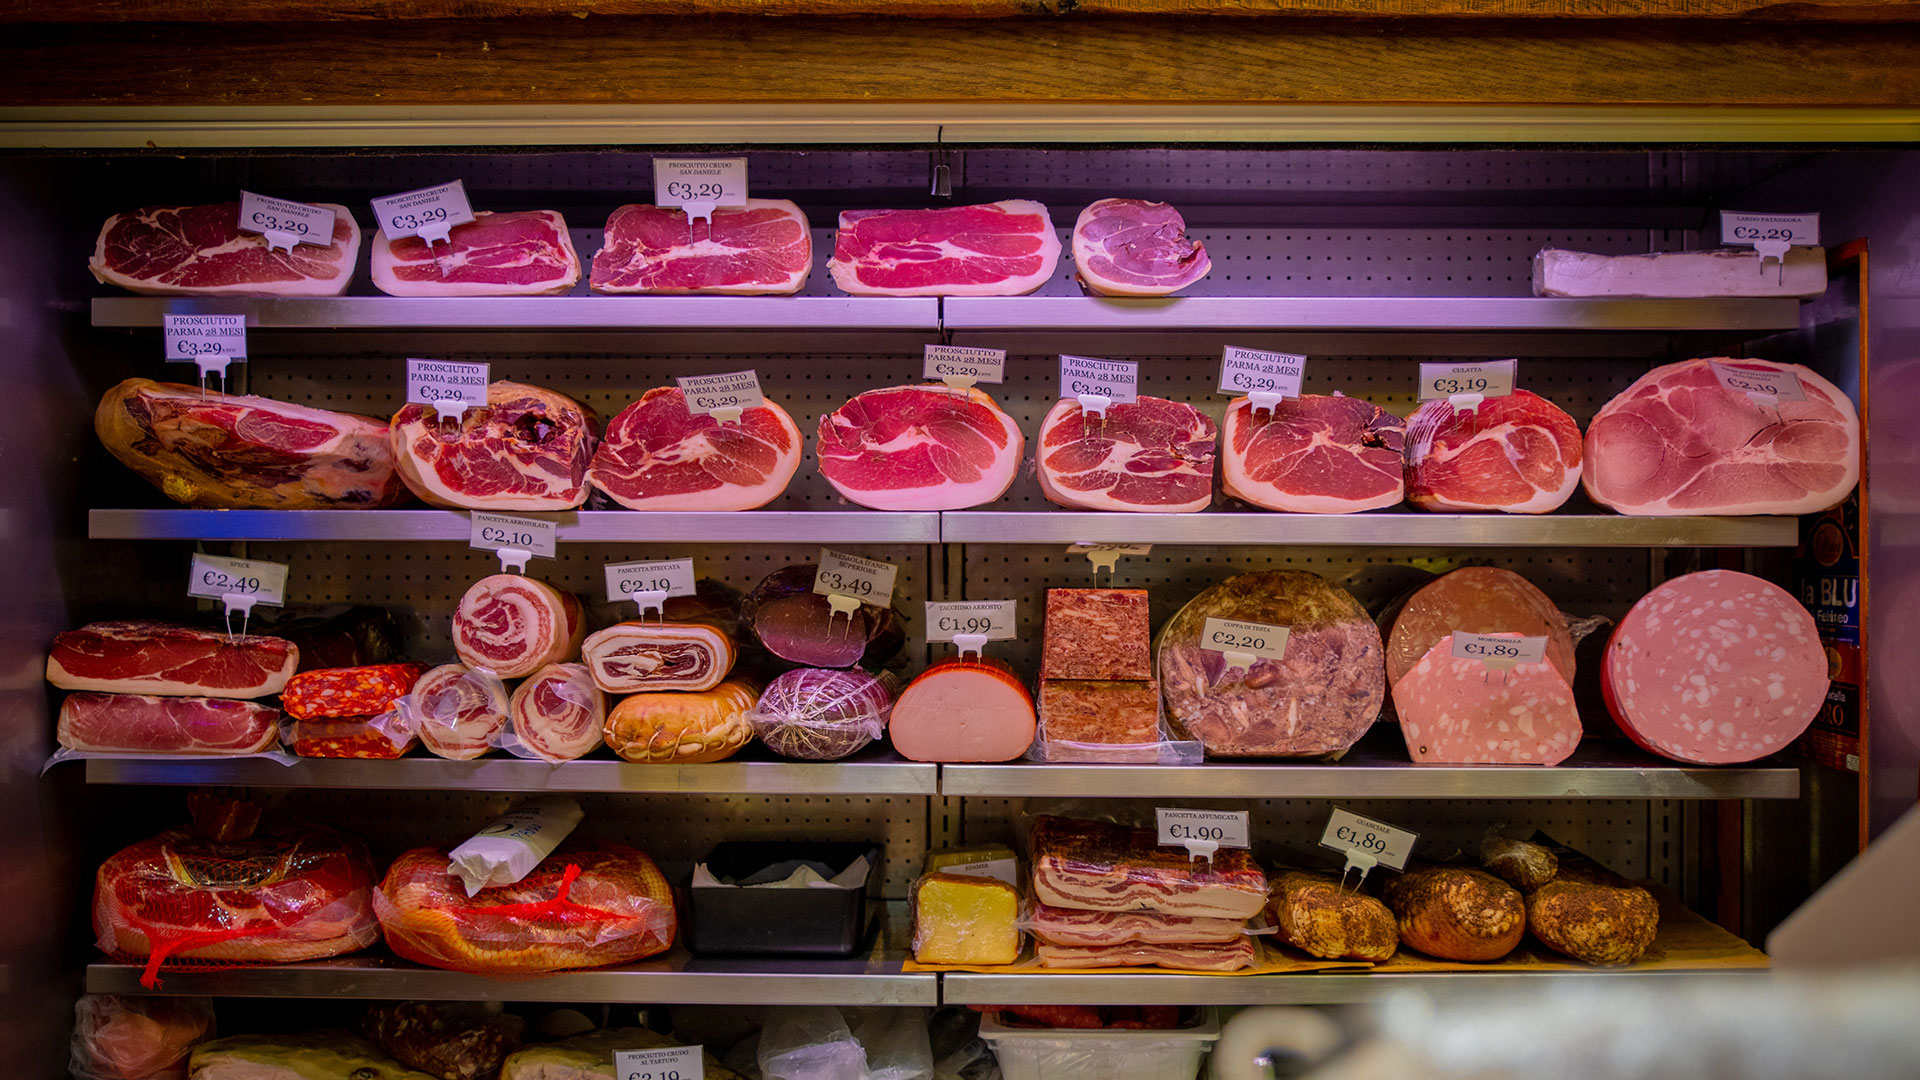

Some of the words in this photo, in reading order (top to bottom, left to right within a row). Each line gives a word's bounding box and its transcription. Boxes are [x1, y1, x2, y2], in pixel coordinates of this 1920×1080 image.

[387, 193, 424, 206] PROSCIUTTO
[425, 187, 449, 197] CRUDO
[668, 182, 723, 200] €3,29
[256, 197, 297, 211] PROSCIUTTO
[298, 205, 322, 215] CRUDO
[399, 202, 412, 210] SAN
[413, 196, 441, 207] DANIELE
[280, 208, 310, 219] DANIELE
[392, 207, 447, 230] €3,29
[251, 212, 309, 236] €3,29
[1734, 226, 1793, 242] €2,29
[173, 317, 237, 325] PROSCIUTTO
[167, 328, 204, 336] PARMA
[219, 328, 244, 336] MESI
[178, 340, 222, 355] €3,29
[934, 347, 996, 357] PROSCIUTTO
[927, 354, 961, 363] PARMA
[977, 357, 1001, 366] MESI
[1235, 351, 1296, 364] PROSCIUTTO
[418, 363, 480, 374] PROSCIUTTO
[936, 363, 978, 377] €3,29
[1070, 360, 1129, 372] PROSCIUTTO
[1227, 360, 1261, 371] PARMA
[1262, 364, 1273, 372] 28
[1275, 366, 1300, 376] MESI
[411, 373, 446, 383] PARMA
[461, 377, 486, 386] MESI
[687, 373, 747, 386] PROSCIUTTO
[1063, 368, 1096, 379] PARMA
[1111, 374, 1135, 383] MESI
[1234, 373, 1275, 391] €3,29
[420, 386, 463, 401] €3,29
[684, 385, 718, 396] PARMA
[719, 384, 730, 394] 28
[732, 381, 757, 391] MESI
[1072, 381, 1112, 397] €3,29
[1434, 378, 1488, 394] €3,19
[1727, 377, 1779, 395] €2,19
[697, 396, 738, 408] €3,29
[478, 515, 510, 525] PANCETTA
[510, 519, 550, 529] ARROTOLATA
[482, 527, 533, 546] €2,10
[230, 561, 251, 569] SPECK
[829, 551, 863, 566] BRESAOLA
[864, 559, 890, 571] D'ANCA
[839, 561, 877, 575] SUPERIORE
[203, 571, 260, 593] €2,49
[620, 578, 670, 593] €2,19
[819, 570, 873, 596] €3,49
[1821, 578, 1857, 608] BLU
[939, 617, 991, 633] €1,99
[1223, 621, 1245, 629] COPPA
[1212, 631, 1266, 650] €2,20
[1477, 636, 1522, 644] MORTADELLA
[1464, 643, 1519, 658] €1,89
[1164, 812, 1196, 820] PANCETTA
[1197, 813, 1239, 821] AFFUMICATA
[1169, 823, 1223, 842] €1,90
[1355, 818, 1391, 834] GUANCIALE
[1337, 826, 1387, 855] €1,89
[650, 1057, 679, 1065] TARTUFO
